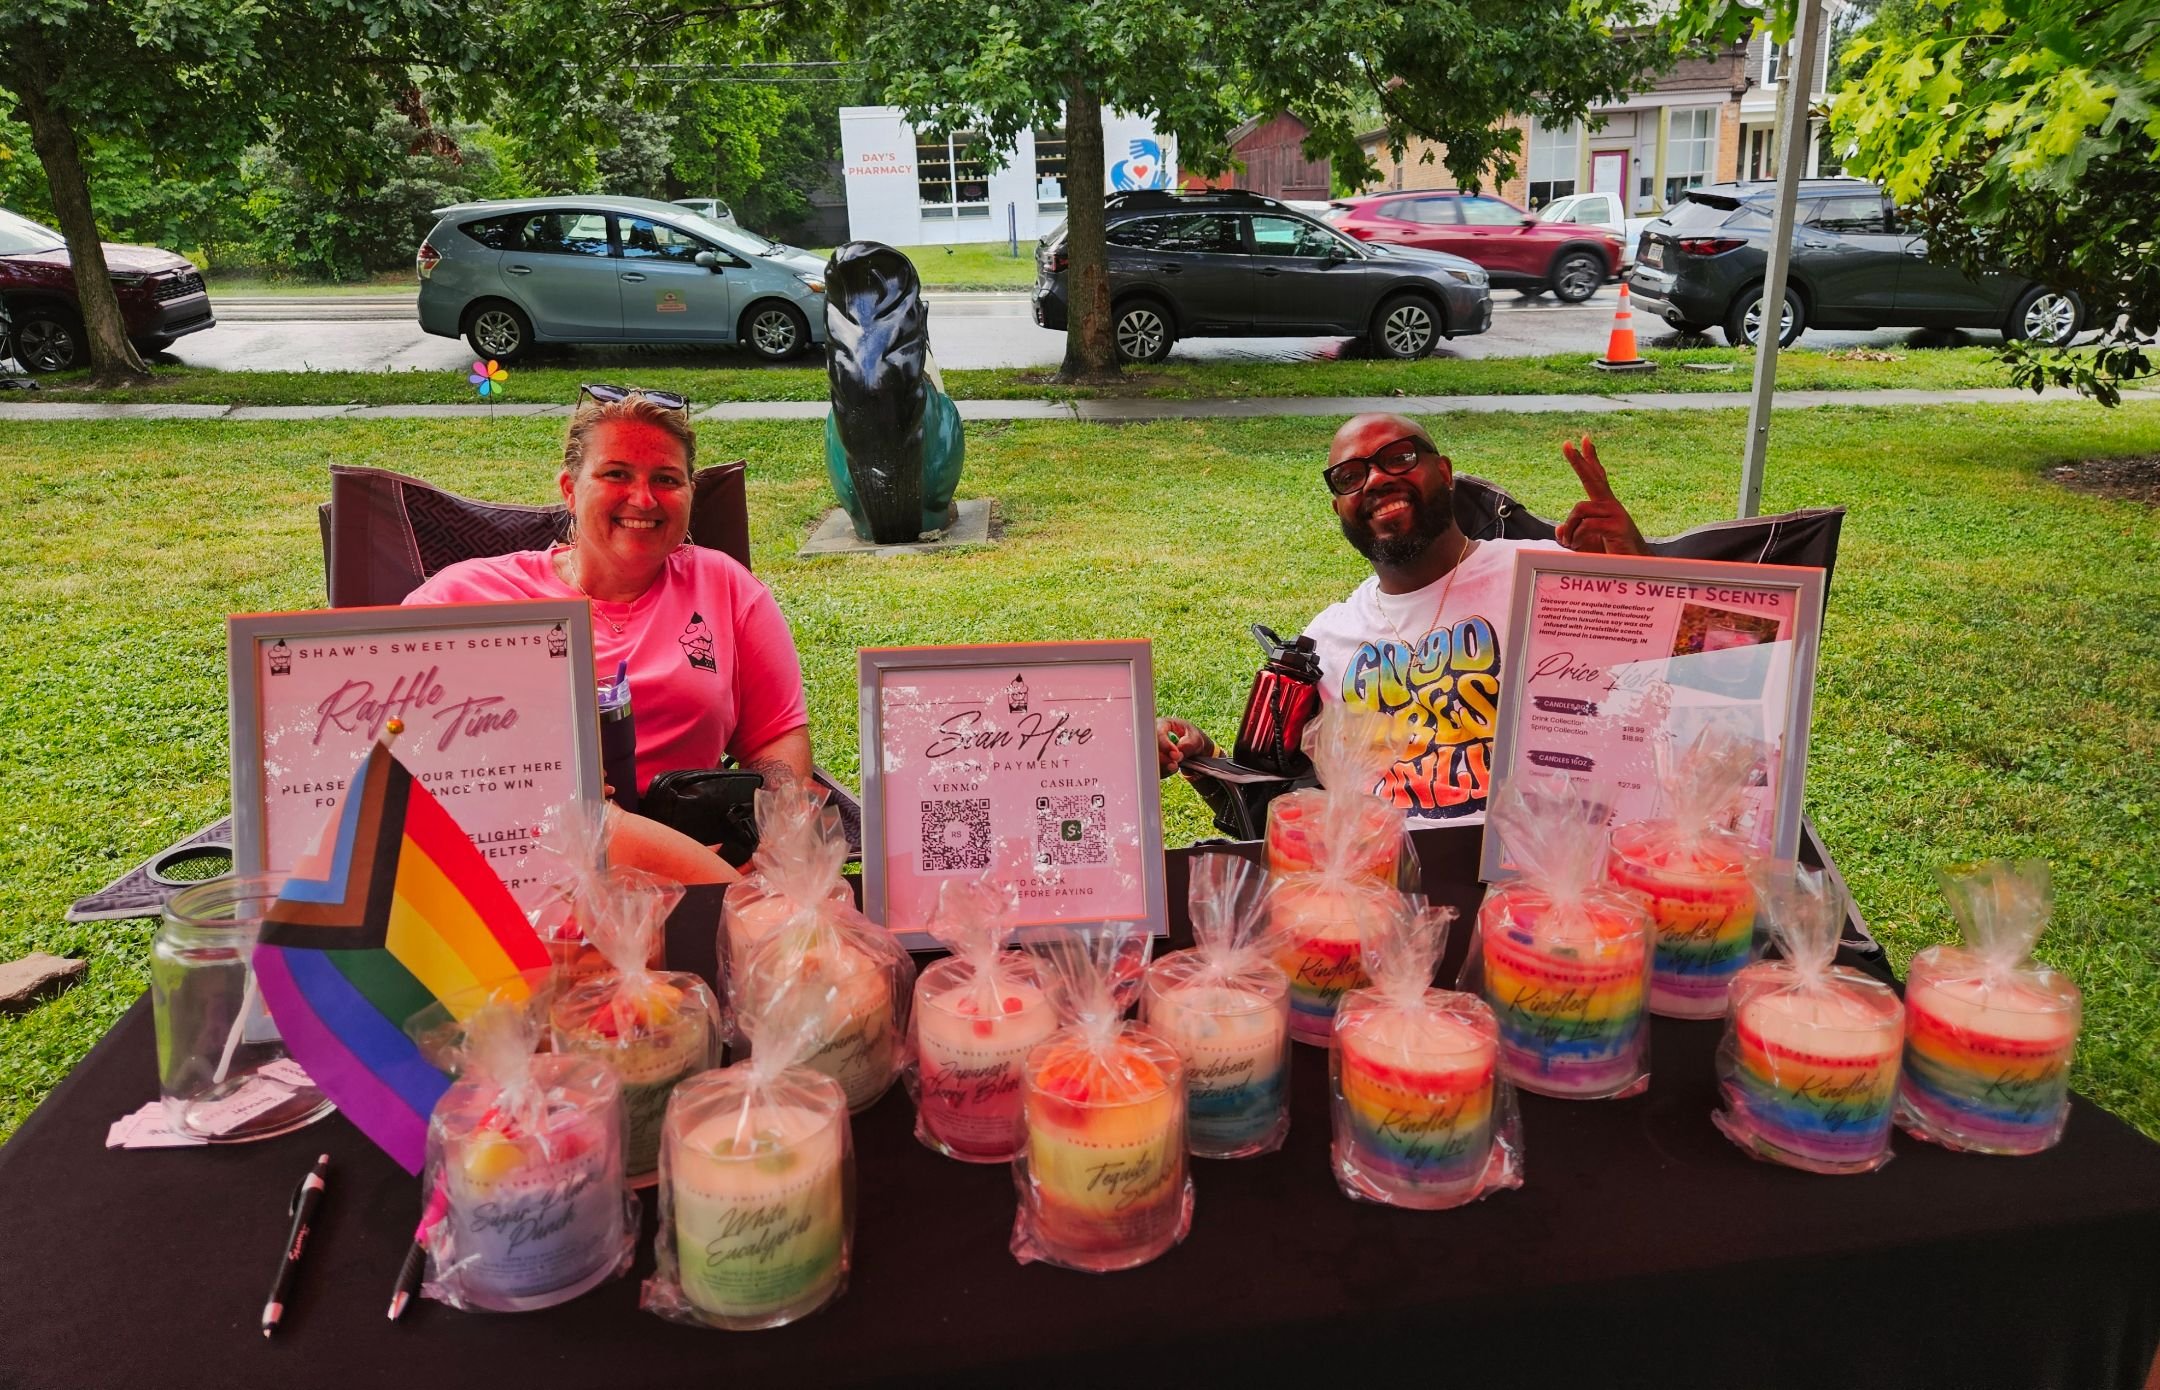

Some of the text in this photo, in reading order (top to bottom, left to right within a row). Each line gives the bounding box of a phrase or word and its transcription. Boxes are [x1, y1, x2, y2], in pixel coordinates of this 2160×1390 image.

[862, 152, 896, 162] DAY'S
[848, 164, 912, 176] PHARMACY
[1559, 575, 1780, 606] SHAW'S SWEET SCENTS
[1540, 597, 1568, 606] Discover
[1581, 600, 1612, 609] exquisite
[1612, 603, 1646, 611] collection
[1541, 606, 1576, 614] decorative
[1606, 611, 1651, 621] meticulously
[1578, 616, 1609, 625] luxurious
[1557, 630, 1581, 638] poured
[1583, 625, 1619, 634] irresistible
[299, 635, 542, 659] SHAW'S SWEET SCENTS
[1342, 614, 1500, 713] GOOD
[1528, 652, 1600, 684] Price
[312, 665, 446, 746] Raffle
[1543, 700, 1575, 710] CANDLES
[432, 695, 520, 752] Time
[1530, 724, 1588, 736] Spring Collection
[925, 709, 1093, 762] Scan Here
[993, 759, 1070, 772] PAYMENT
[1538, 754, 1569, 764] CANDLES
[282, 780, 346, 795] PLEASE
[461, 765, 517, 779] TICKET
[523, 761, 563, 772] HERE
[933, 778, 1099, 793] VENMO CASHAPP
[430, 785, 471, 796] ANCE
[478, 783, 497, 792] TO
[504, 779, 533, 790] WIN
[468, 828, 527, 843] ELIGHT
[1018, 887, 1094, 899] EFORE PAYING
[1508, 985, 1598, 1022] Kindled
[1376, 1100, 1466, 1144] Kindled
[1085, 1150, 1150, 1195] Tequila
[470, 1202, 530, 1234] Sugar
[717, 1202, 788, 1239] White
[507, 1202, 576, 1255] Punch
